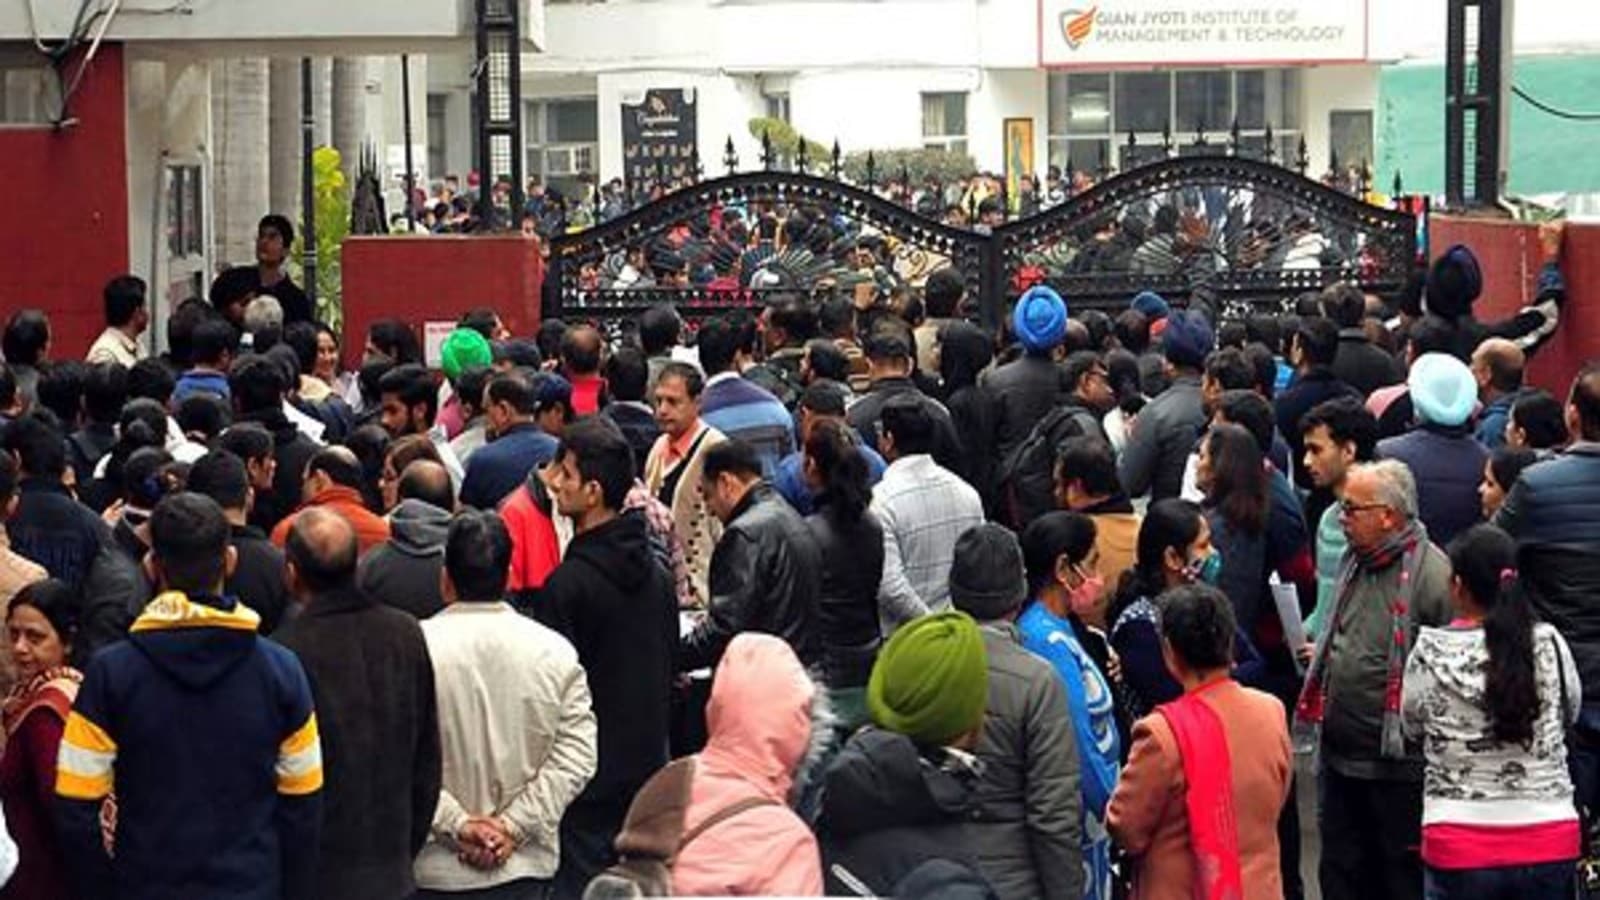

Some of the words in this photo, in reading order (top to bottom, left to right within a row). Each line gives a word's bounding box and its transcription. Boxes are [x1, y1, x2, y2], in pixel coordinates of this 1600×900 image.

[1095, 10, 1136, 25] GIAN
[1140, 10, 1186, 25] JYOTI
[1191, 9, 1271, 24] INSTITUTE
[1275, 8, 1298, 24] OF
[1095, 28, 1210, 42] MANAGEMENT
[1235, 25, 1345, 42] TECHNOLOGY
